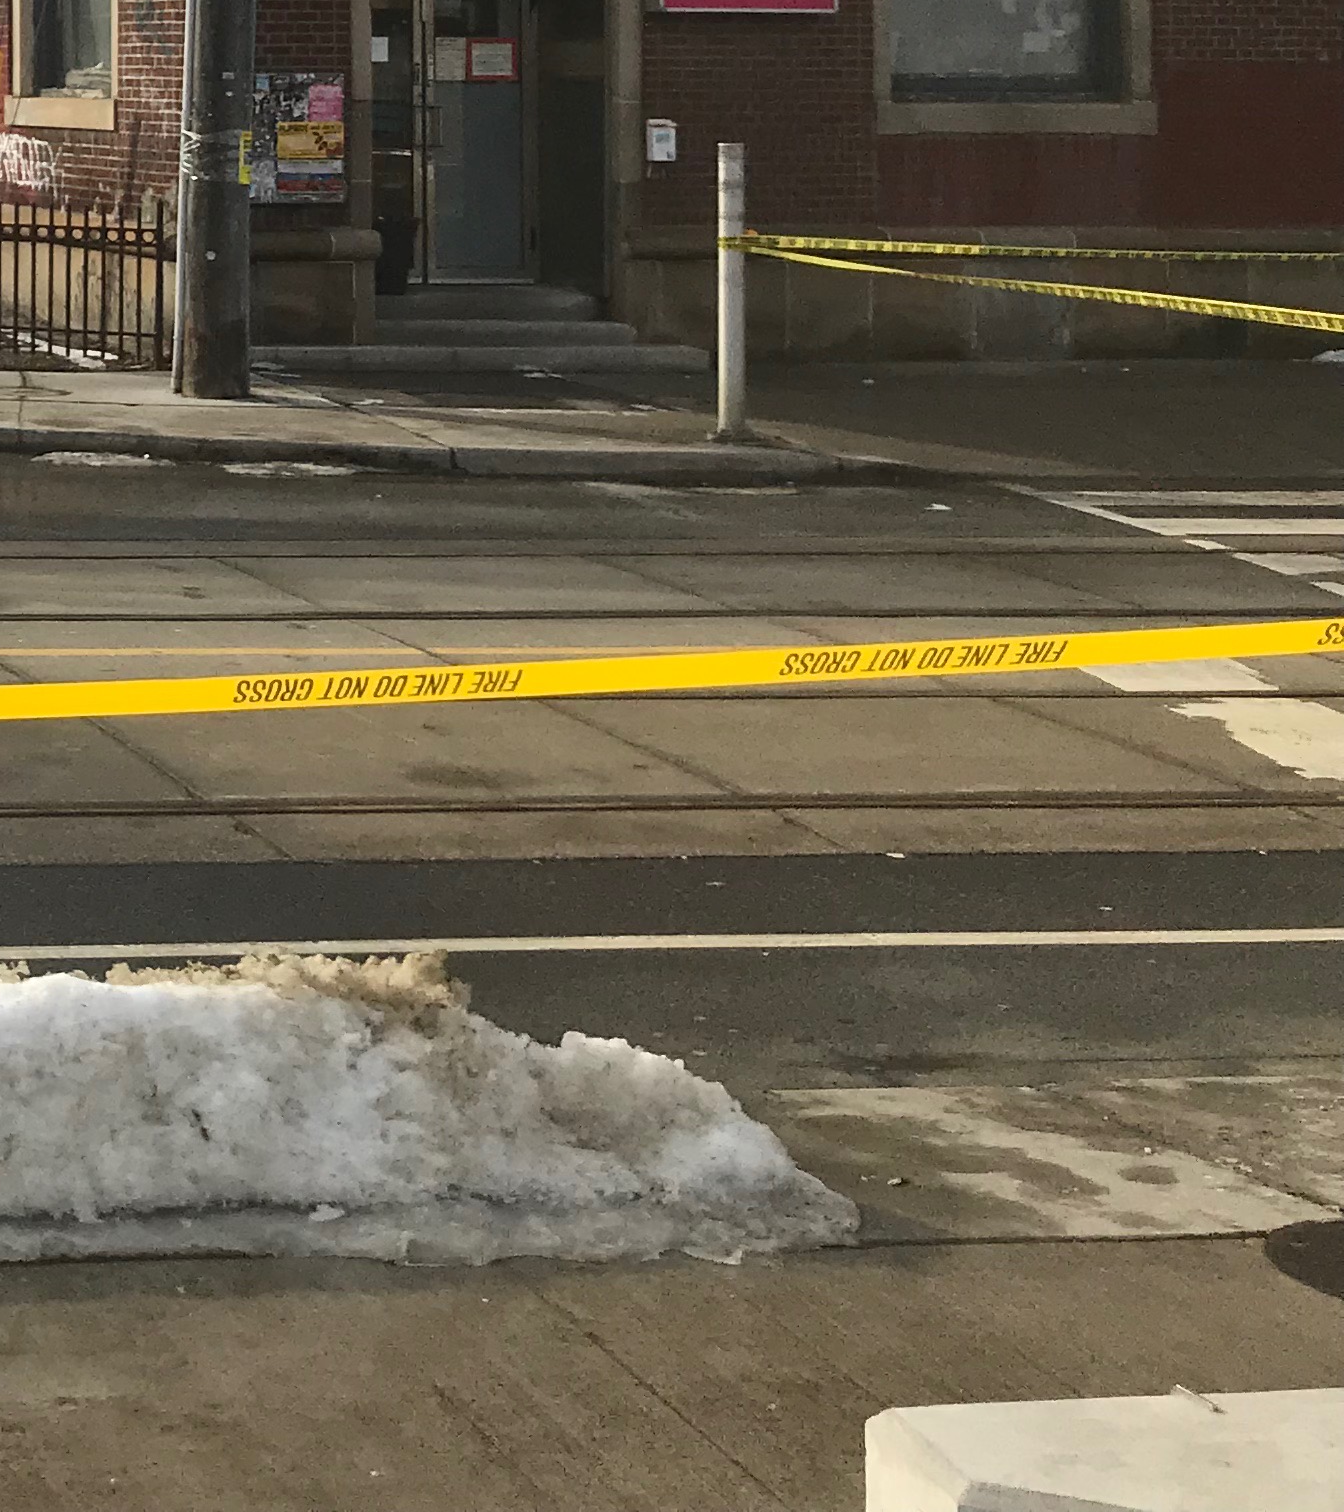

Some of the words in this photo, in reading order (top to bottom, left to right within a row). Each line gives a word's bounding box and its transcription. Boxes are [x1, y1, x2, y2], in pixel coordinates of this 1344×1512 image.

[779, 649, 860, 676] CROSS
[860, 647, 915, 672] NOT
[918, 645, 953, 669] DO
[957, 642, 1009, 667] LINE
[1015, 640, 1069, 666] FIRE
[232, 678, 314, 704] CROSS
[317, 676, 369, 701] NOT
[373, 674, 408, 699] DO
[412, 672, 464, 697] LINE
[467, 668, 524, 694] FIRE
